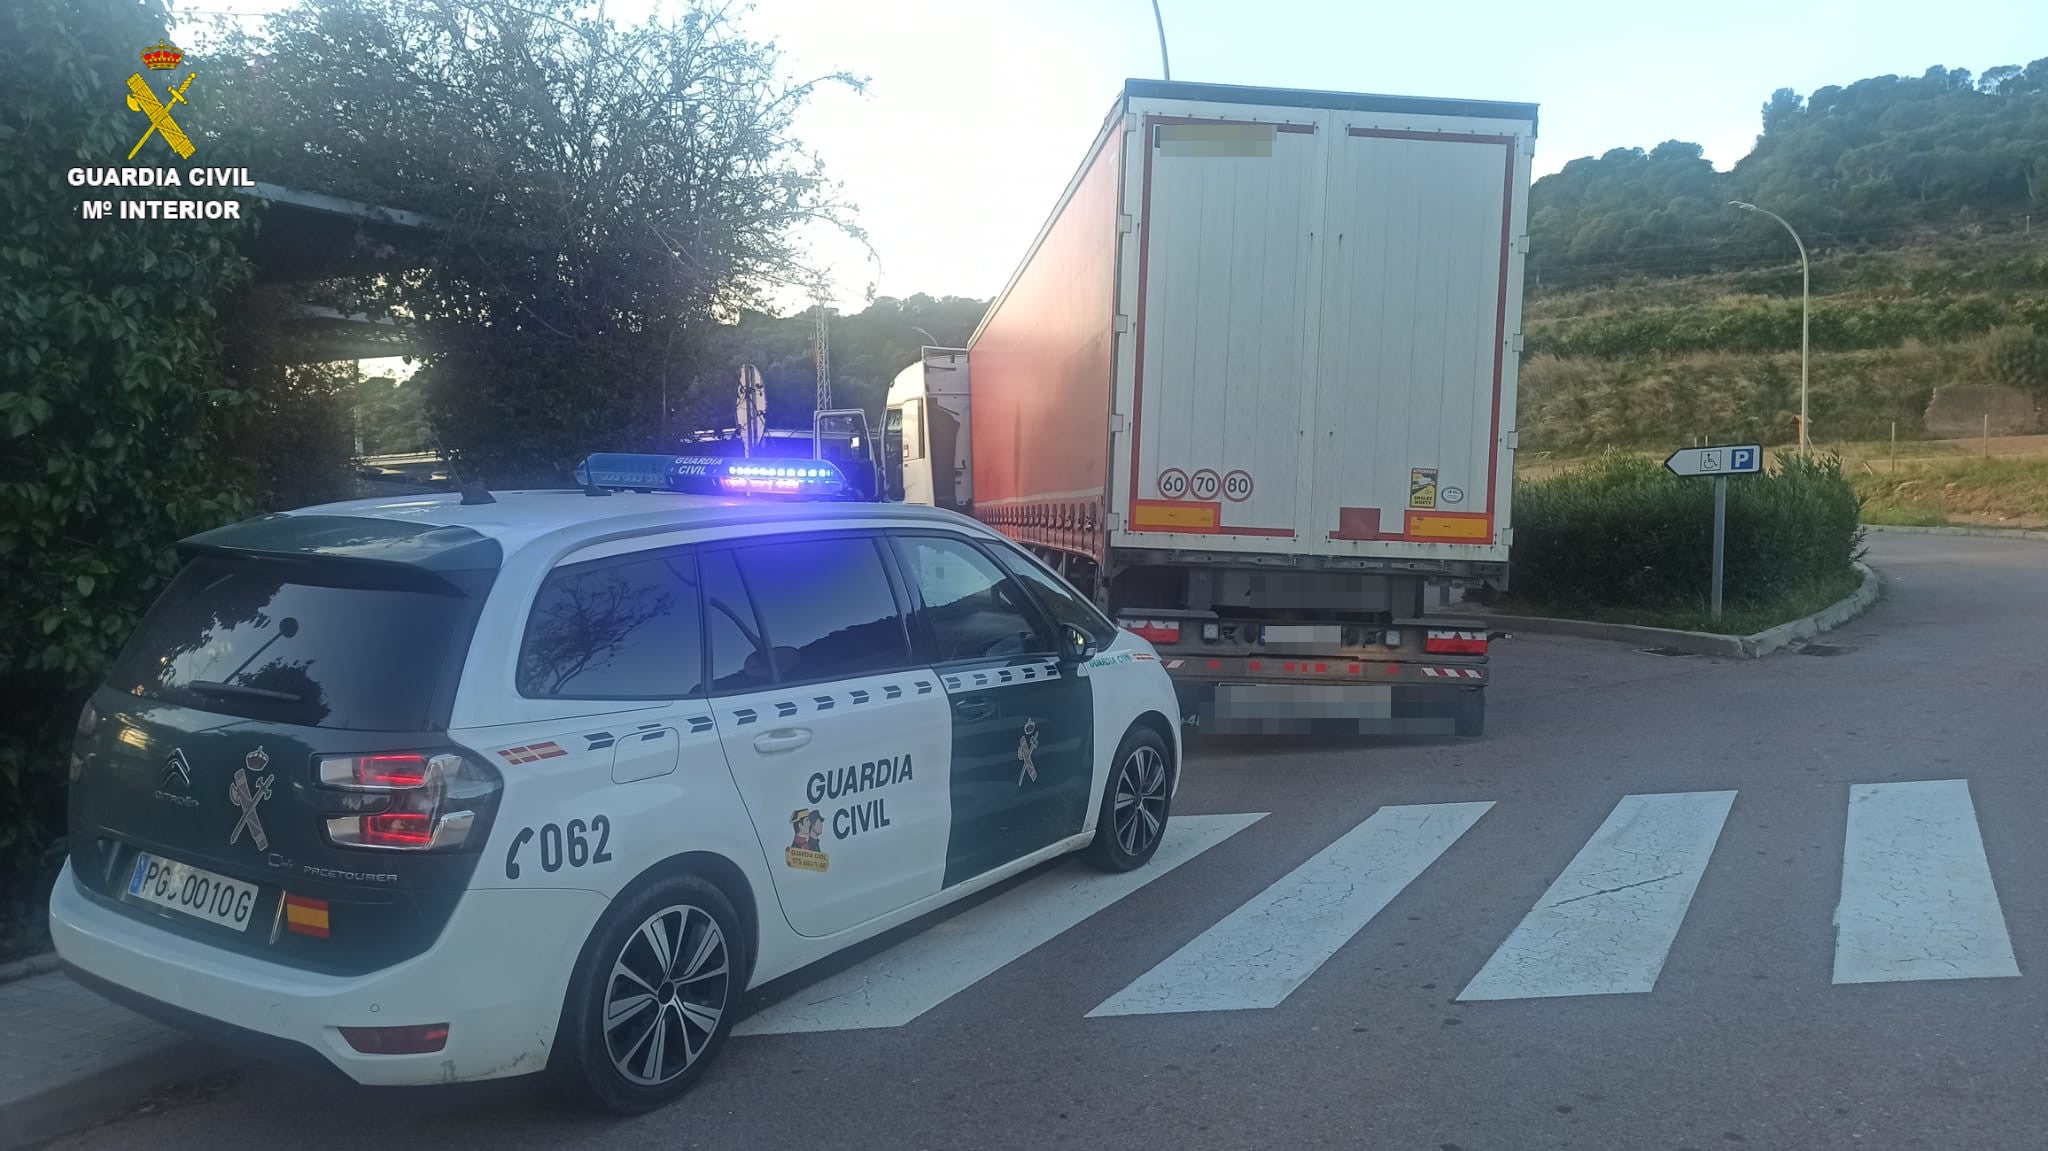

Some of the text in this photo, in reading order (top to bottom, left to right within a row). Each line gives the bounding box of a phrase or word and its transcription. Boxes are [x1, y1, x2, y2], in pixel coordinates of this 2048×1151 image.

[674, 456, 723, 465] GUARDIA
[1734, 450, 1750, 468] P
[678, 465, 707, 475] CIVIL
[1162, 475, 1249, 494] 60 70 80
[806, 753, 913, 805] GUARDIA
[832, 798, 891, 840] CIVIL
[540, 814, 612, 873] 062
